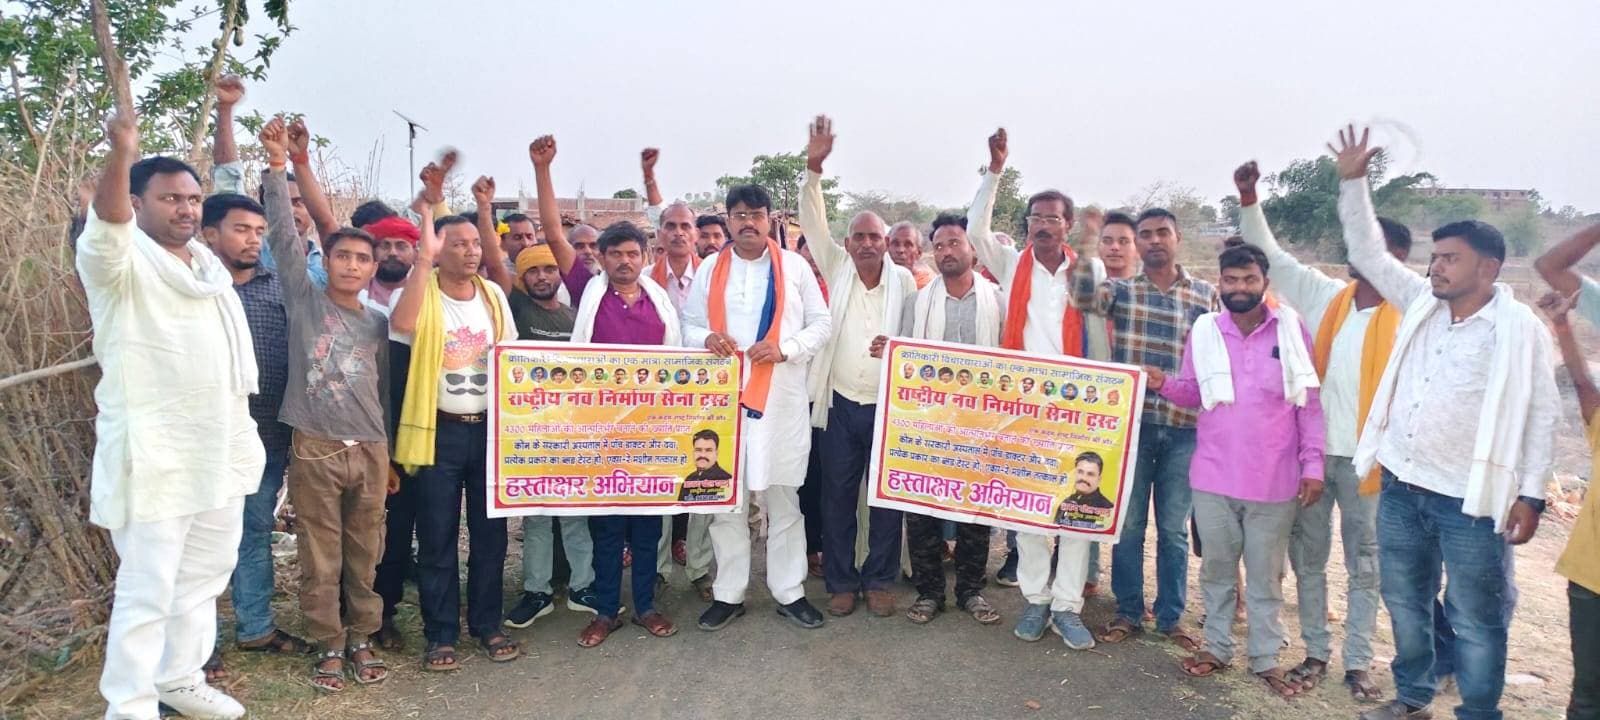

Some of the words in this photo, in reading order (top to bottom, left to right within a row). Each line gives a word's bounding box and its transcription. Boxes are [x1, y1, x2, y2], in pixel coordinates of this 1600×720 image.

[508, 387, 561, 410] राष्ट्रीय
[568, 392, 593, 405] नव
[599, 387, 656, 406] निर्माण
[661, 389, 694, 406] सेना
[700, 393, 730, 411] ट्रस्ट
[897, 385, 947, 407] राष्ट्रीय
[952, 393, 977, 409] नव
[983, 394, 1040, 418] निर्माण
[1046, 402, 1081, 424] सेना
[1086, 411, 1119, 431] ट्रस्ट
[572, 441, 600, 450] अस्पताल
[649, 438, 661, 449] और
[549, 456, 560, 464] का
[505, 476, 588, 497] हस्ताक्षर
[593, 469, 677, 495] अभियान
[888, 469, 965, 501] हस्ताक्षर
[969, 478, 1053, 515] अभियान
